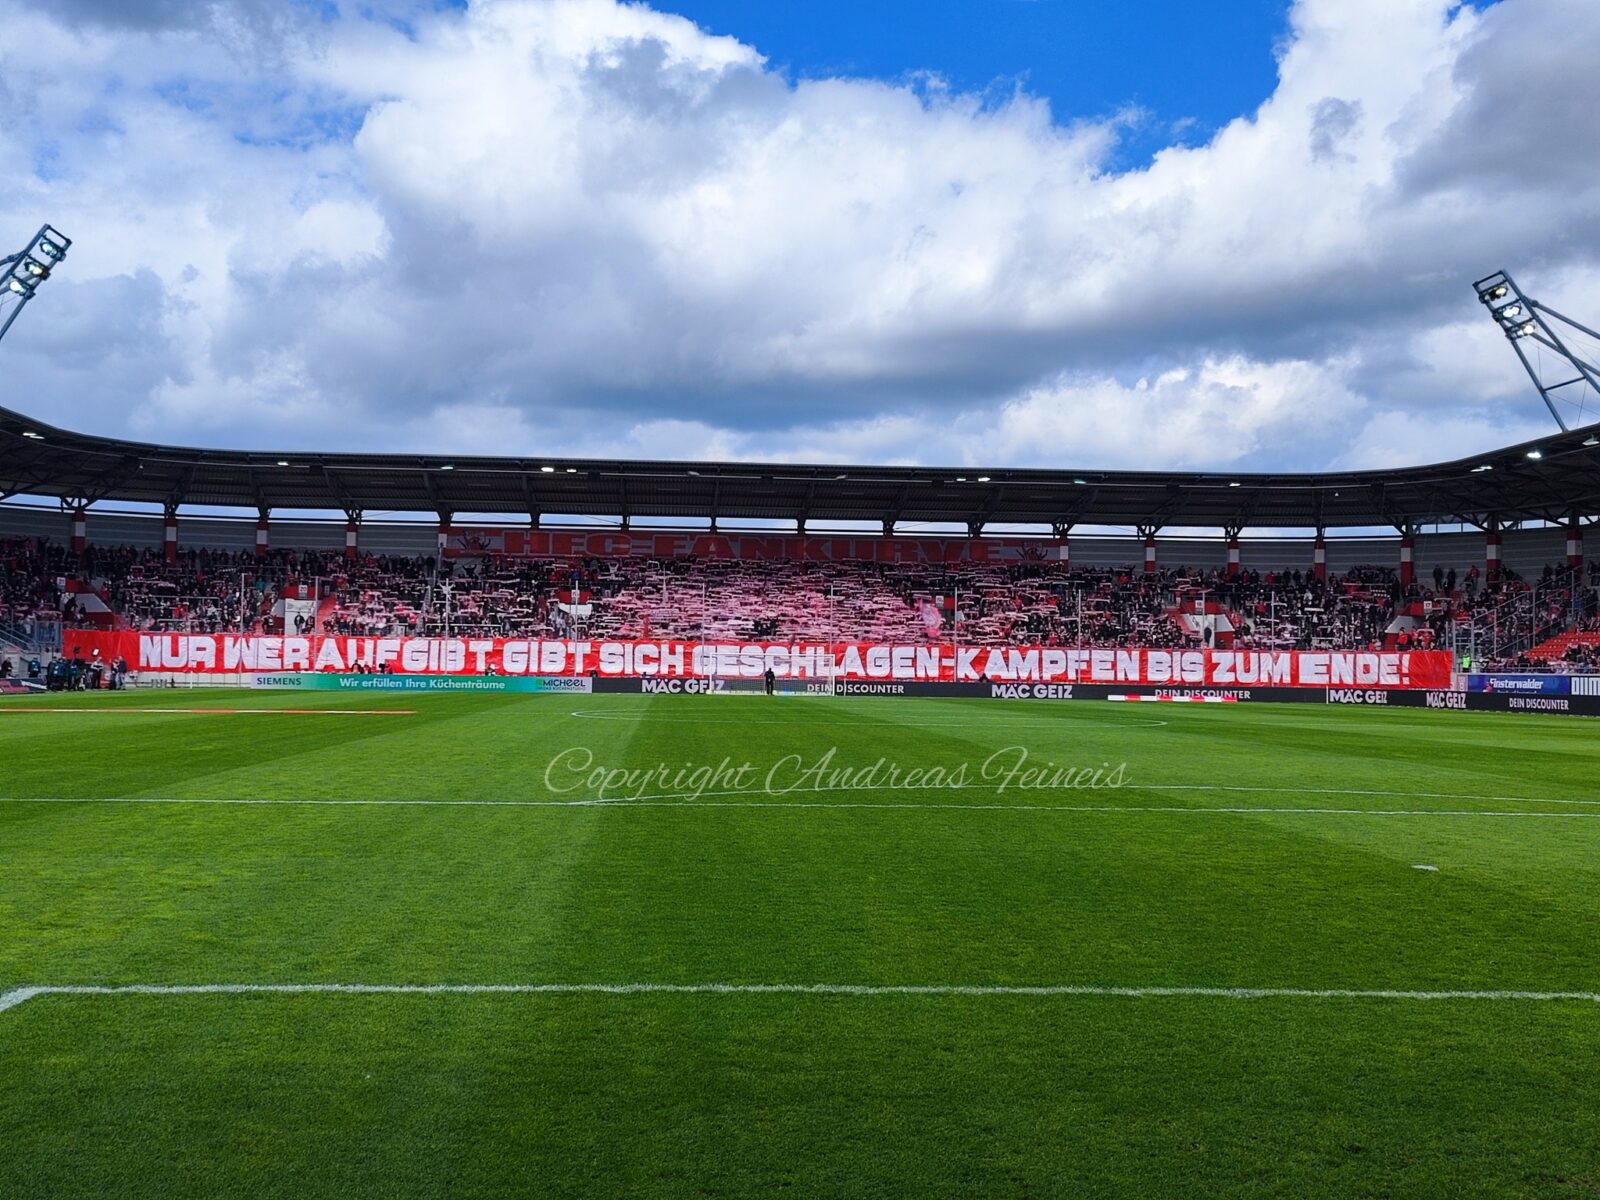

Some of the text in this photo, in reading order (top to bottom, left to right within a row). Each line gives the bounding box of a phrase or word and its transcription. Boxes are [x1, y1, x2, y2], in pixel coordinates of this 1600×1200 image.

[503, 530, 1003, 562] HFC FANKURVE
[139, 635, 217, 668] NUR
[223, 636, 310, 670] WER
[502, 641, 592, 674] GIBT
[599, 642, 684, 675] SICH
[1147, 651, 1204, 682] BIS
[1211, 652, 1291, 684] ZUM
[1298, 653, 1411, 685] ENDE!
[256, 677, 302, 686] SIEMENS
[339, 678, 506, 689] Wir erfüllen Ihre Küchenträume
[641, 678, 682, 694] MÄC
[807, 684, 833, 692] DEIN
[991, 683, 1073, 699] MÄC GEIZ
[1155, 689, 1251, 699] DEIN DISCOUNTER
[1329, 688, 1388, 704] MÄC GEIZ
[1426, 692, 1467, 709] MÄC GEIZ
[1509, 697, 1569, 710] DEIN DISCOUNTER
